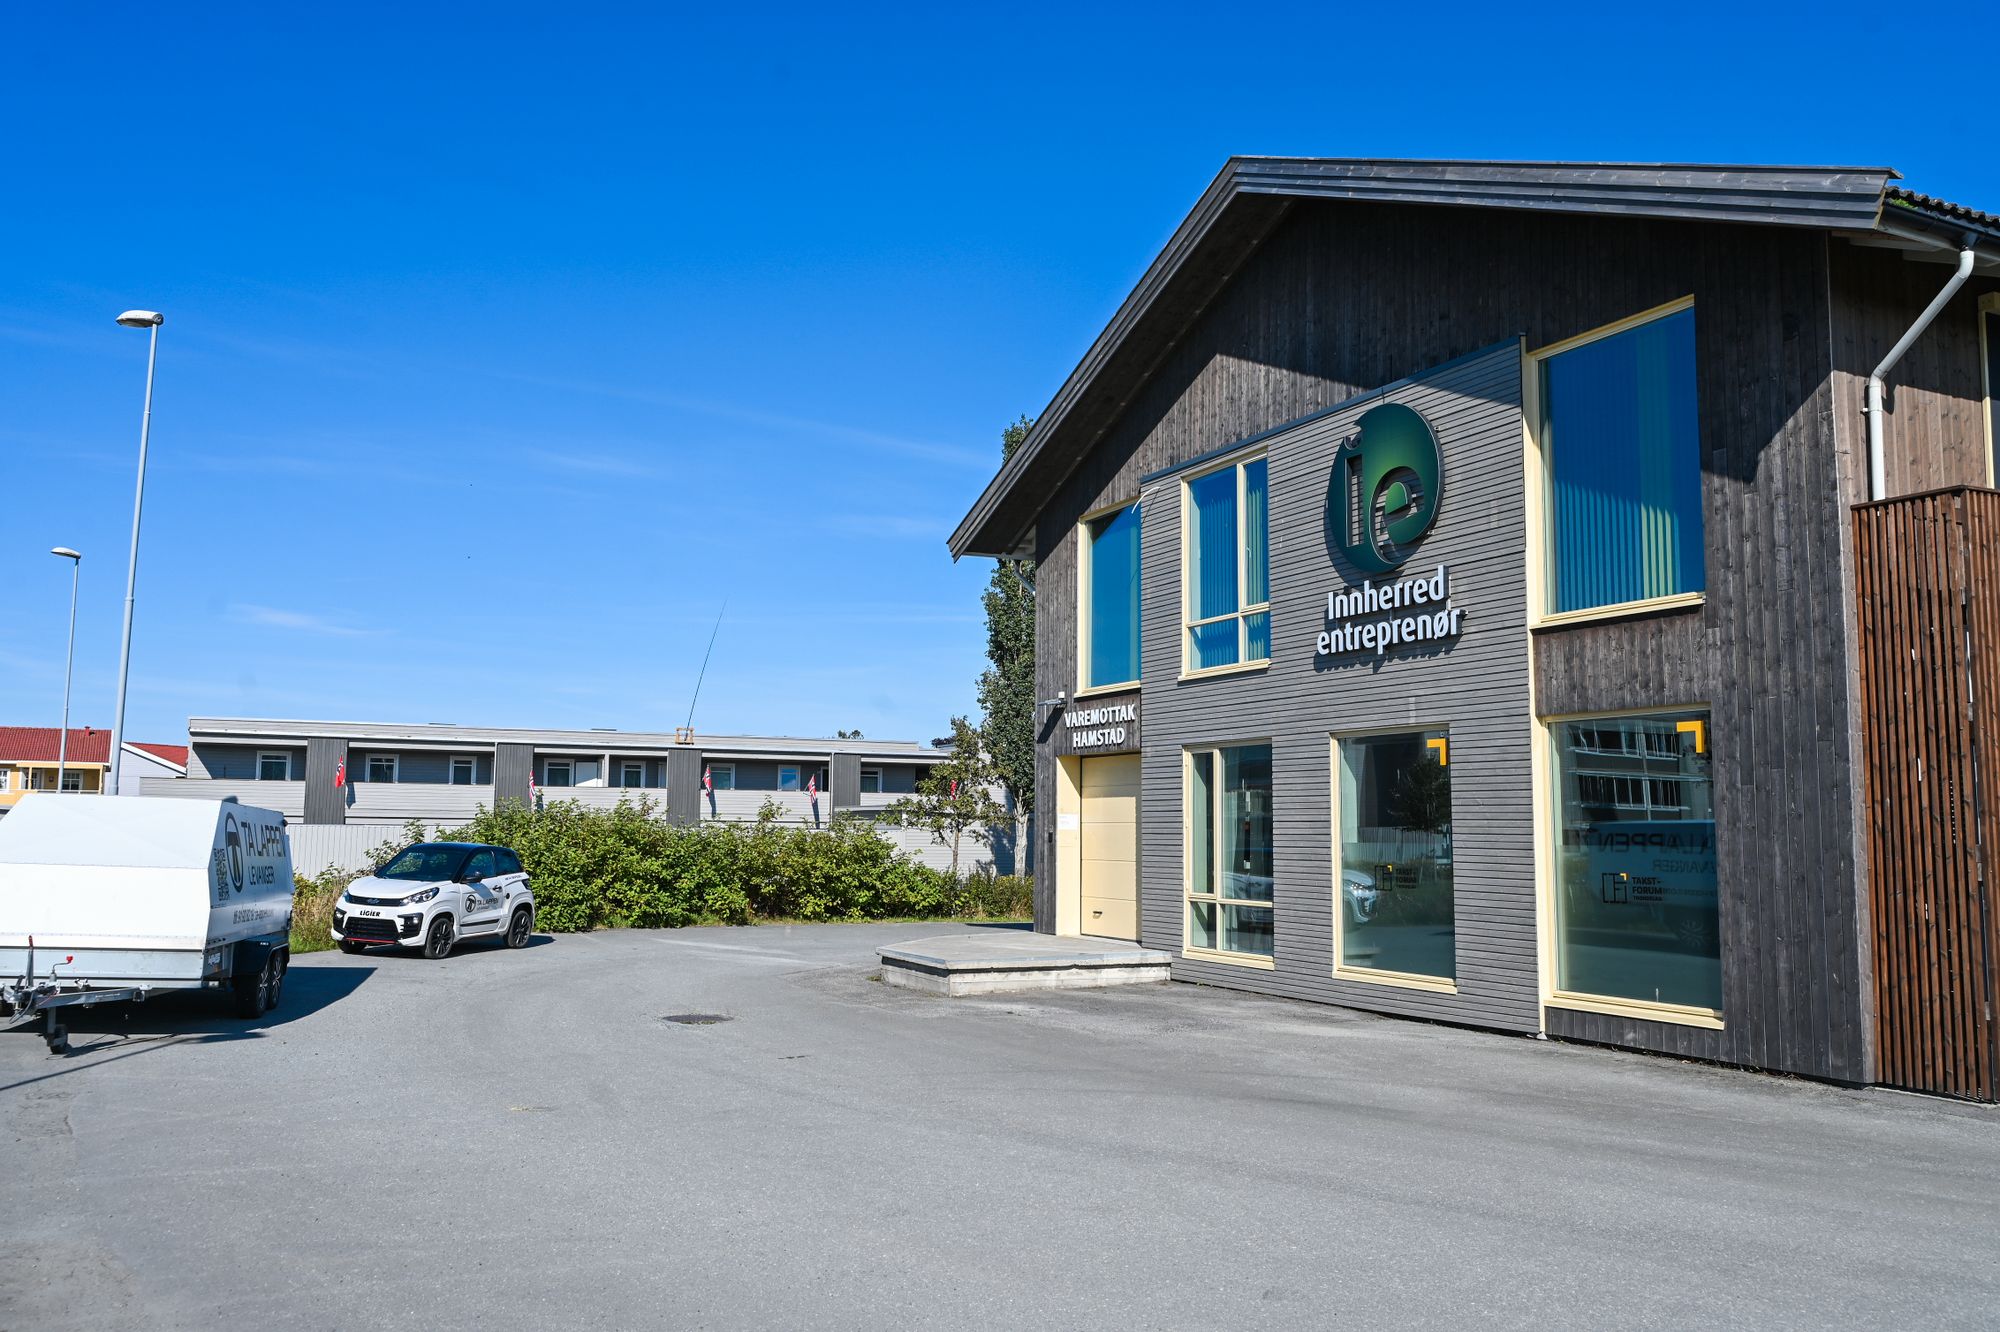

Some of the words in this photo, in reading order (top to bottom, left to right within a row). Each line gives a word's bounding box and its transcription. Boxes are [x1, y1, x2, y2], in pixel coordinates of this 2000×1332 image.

[1328, 564, 1445, 620] Innherred
[1317, 608, 1461, 655] entreprenør
[1064, 704, 1135, 728] VAREMOTTAK
[1073, 727, 1125, 748] HAMSTAD
[241, 821, 256, 856] TA
[248, 866, 275, 885] LEVANGER
[1632, 886, 1662, 895] FORUM
